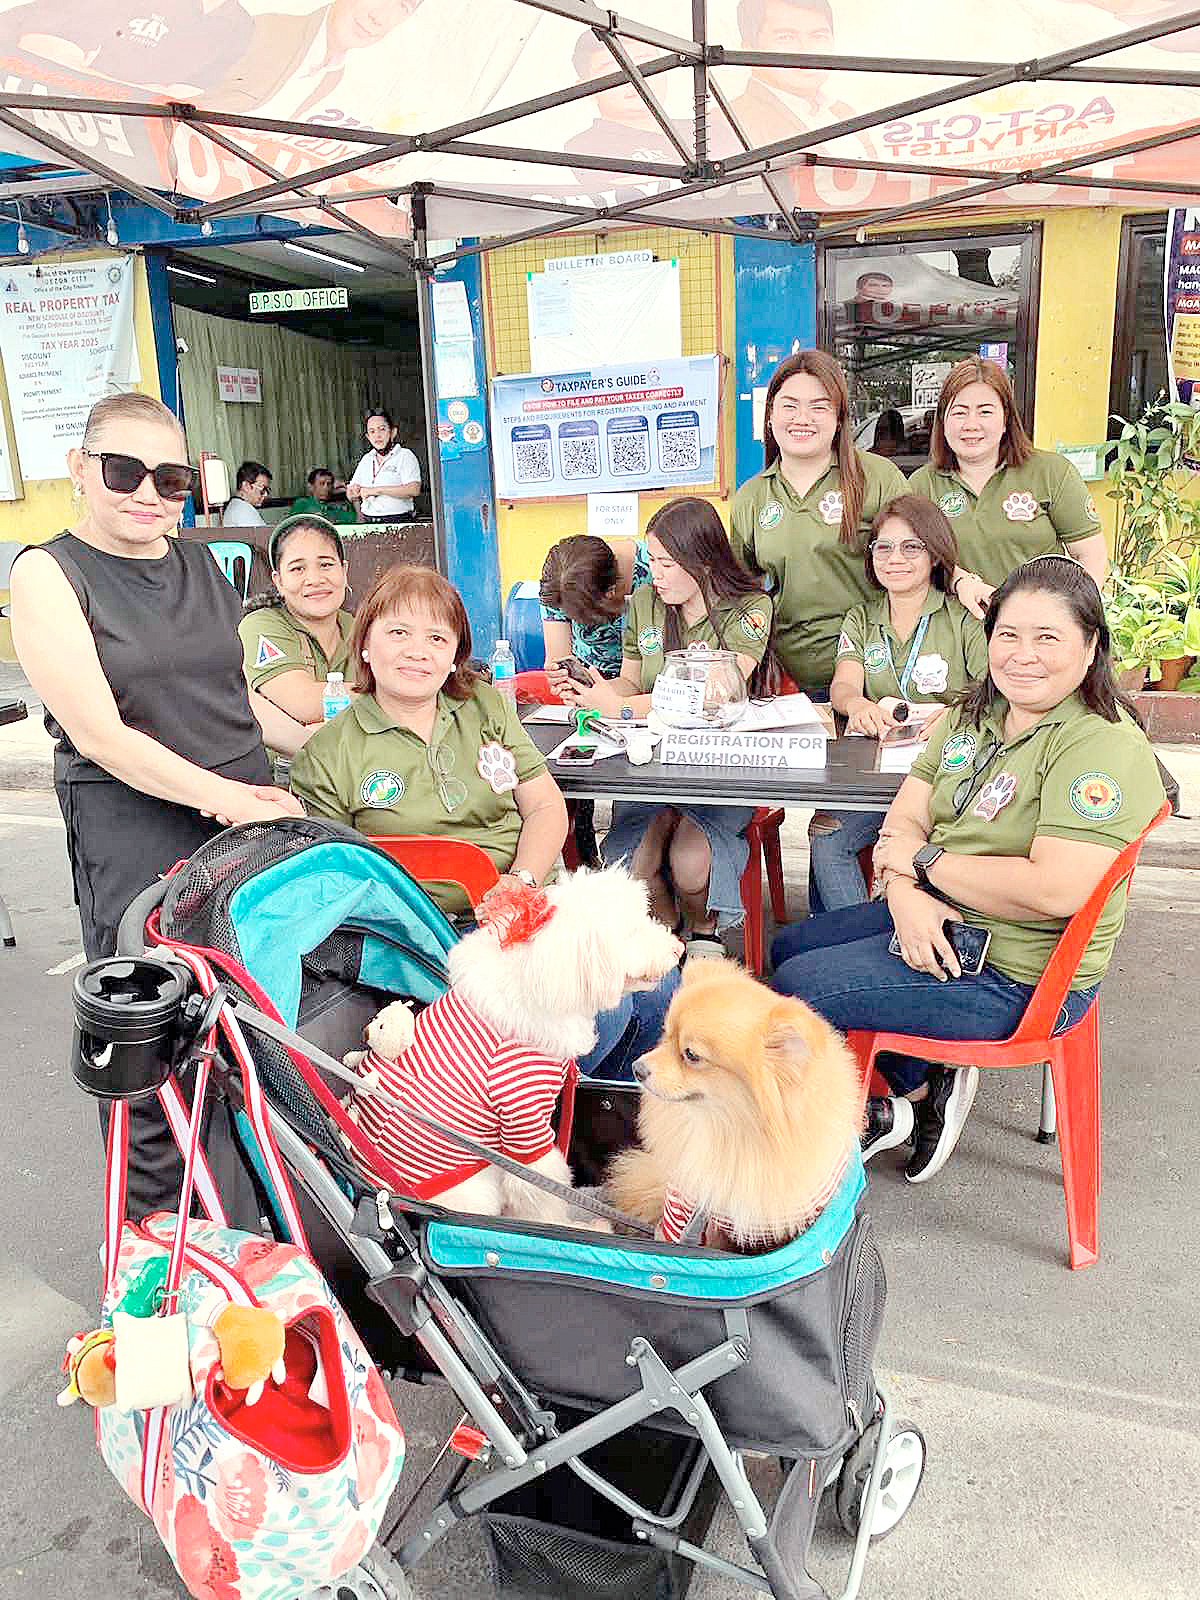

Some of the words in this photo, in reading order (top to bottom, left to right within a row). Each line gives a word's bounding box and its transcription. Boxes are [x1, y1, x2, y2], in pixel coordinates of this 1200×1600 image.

[548, 257, 603, 272] BULLETIN
[609, 252, 650, 265] BOARD
[5, 301, 36, 314] REAL
[40, 295, 99, 312] PROPERTY
[103, 291, 120, 306] TAX
[303, 290, 346, 307] OFFICE
[40, 341, 57, 350] TAX
[59, 339, 79, 349] YEAR
[80, 338, 99, 348] 2025
[556, 378, 614, 393] TAXPAYER'S
[616, 374, 647, 386] GUIDE
[645, 388, 683, 399] CORRECTLY
[664, 401, 677, 409] AND
[678, 398, 708, 408] PAYMENT
[612, 505, 633, 513] STAFF
[604, 517, 625, 525] ONLY
[666, 733, 786, 749] REGISTRATION
[788, 736, 823, 750] FOR
[665, 751, 788, 767] PAWSHIONISTA
